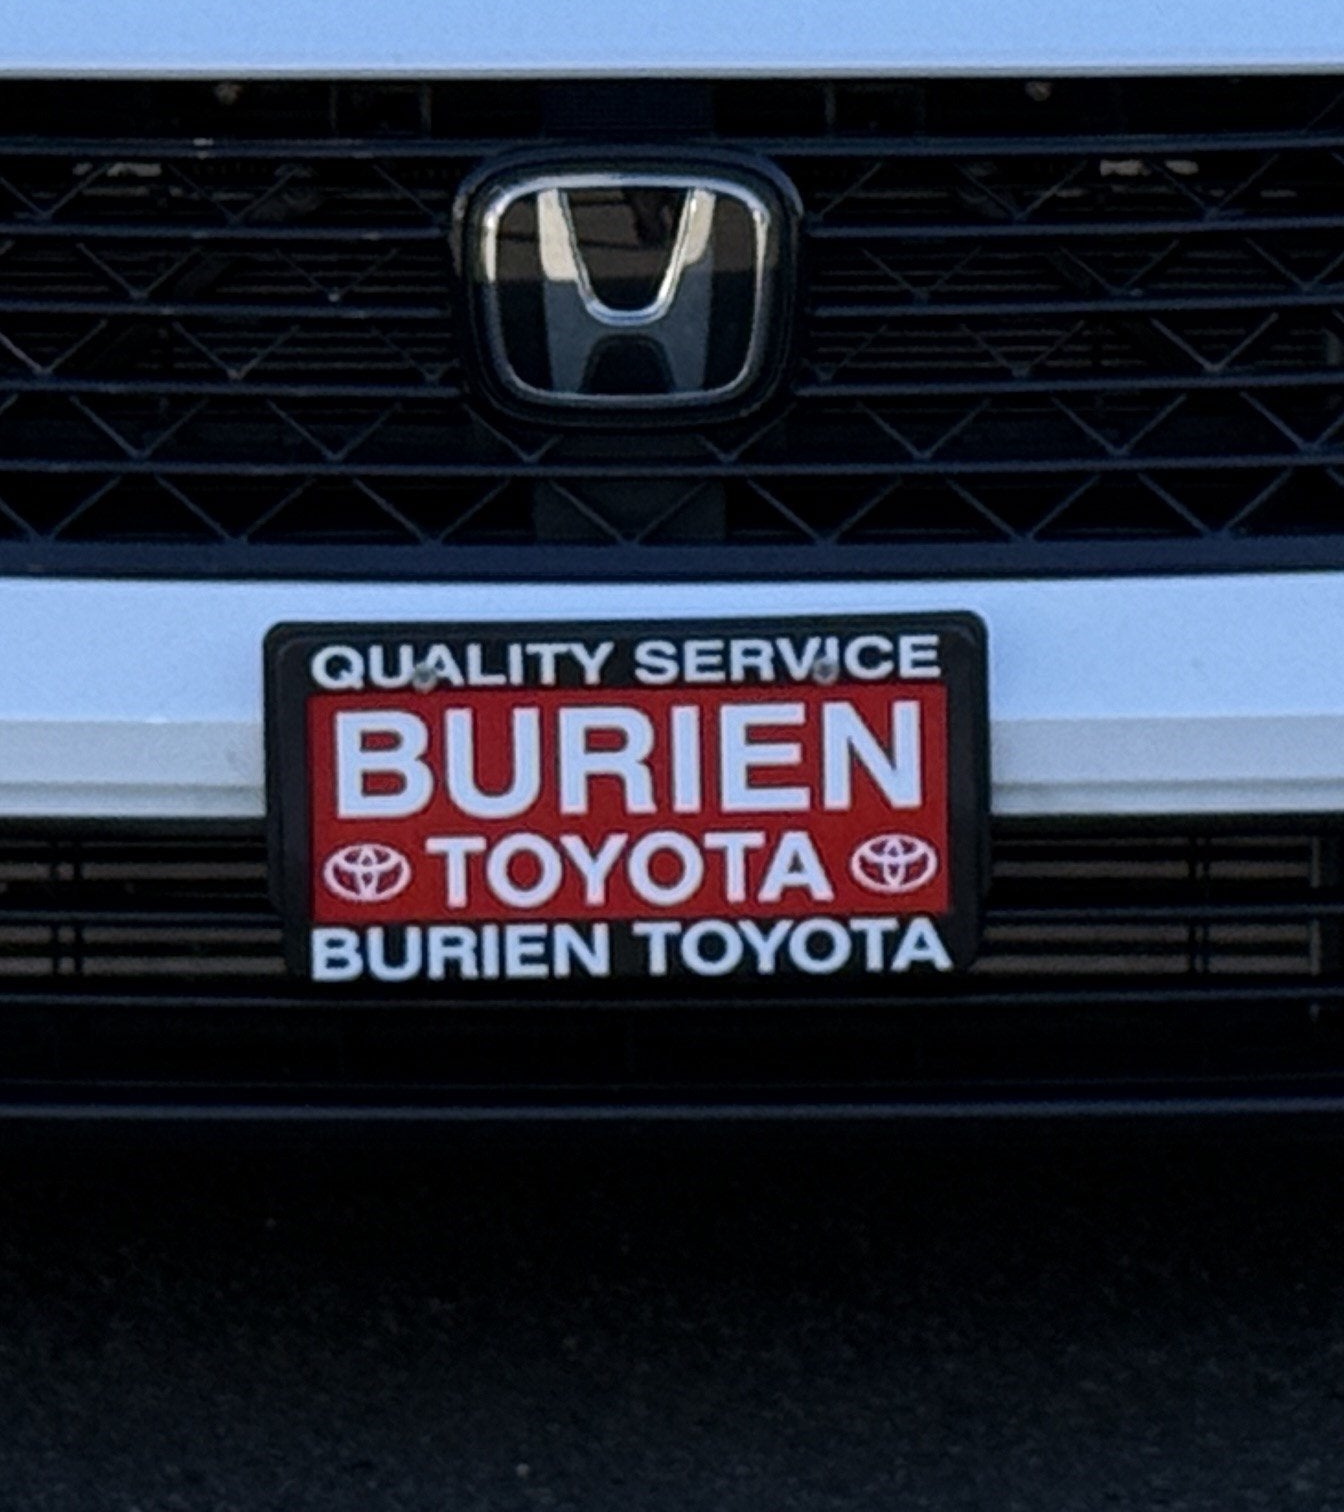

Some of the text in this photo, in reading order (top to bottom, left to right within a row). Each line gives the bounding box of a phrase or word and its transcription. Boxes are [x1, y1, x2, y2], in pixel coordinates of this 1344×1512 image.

[311, 634, 942, 690] QUALITY SERVICE
[334, 700, 922, 820] BURIEN
[424, 831, 835, 908] TOYOTA
[311, 917, 953, 981] BURIEN TOYOTA
